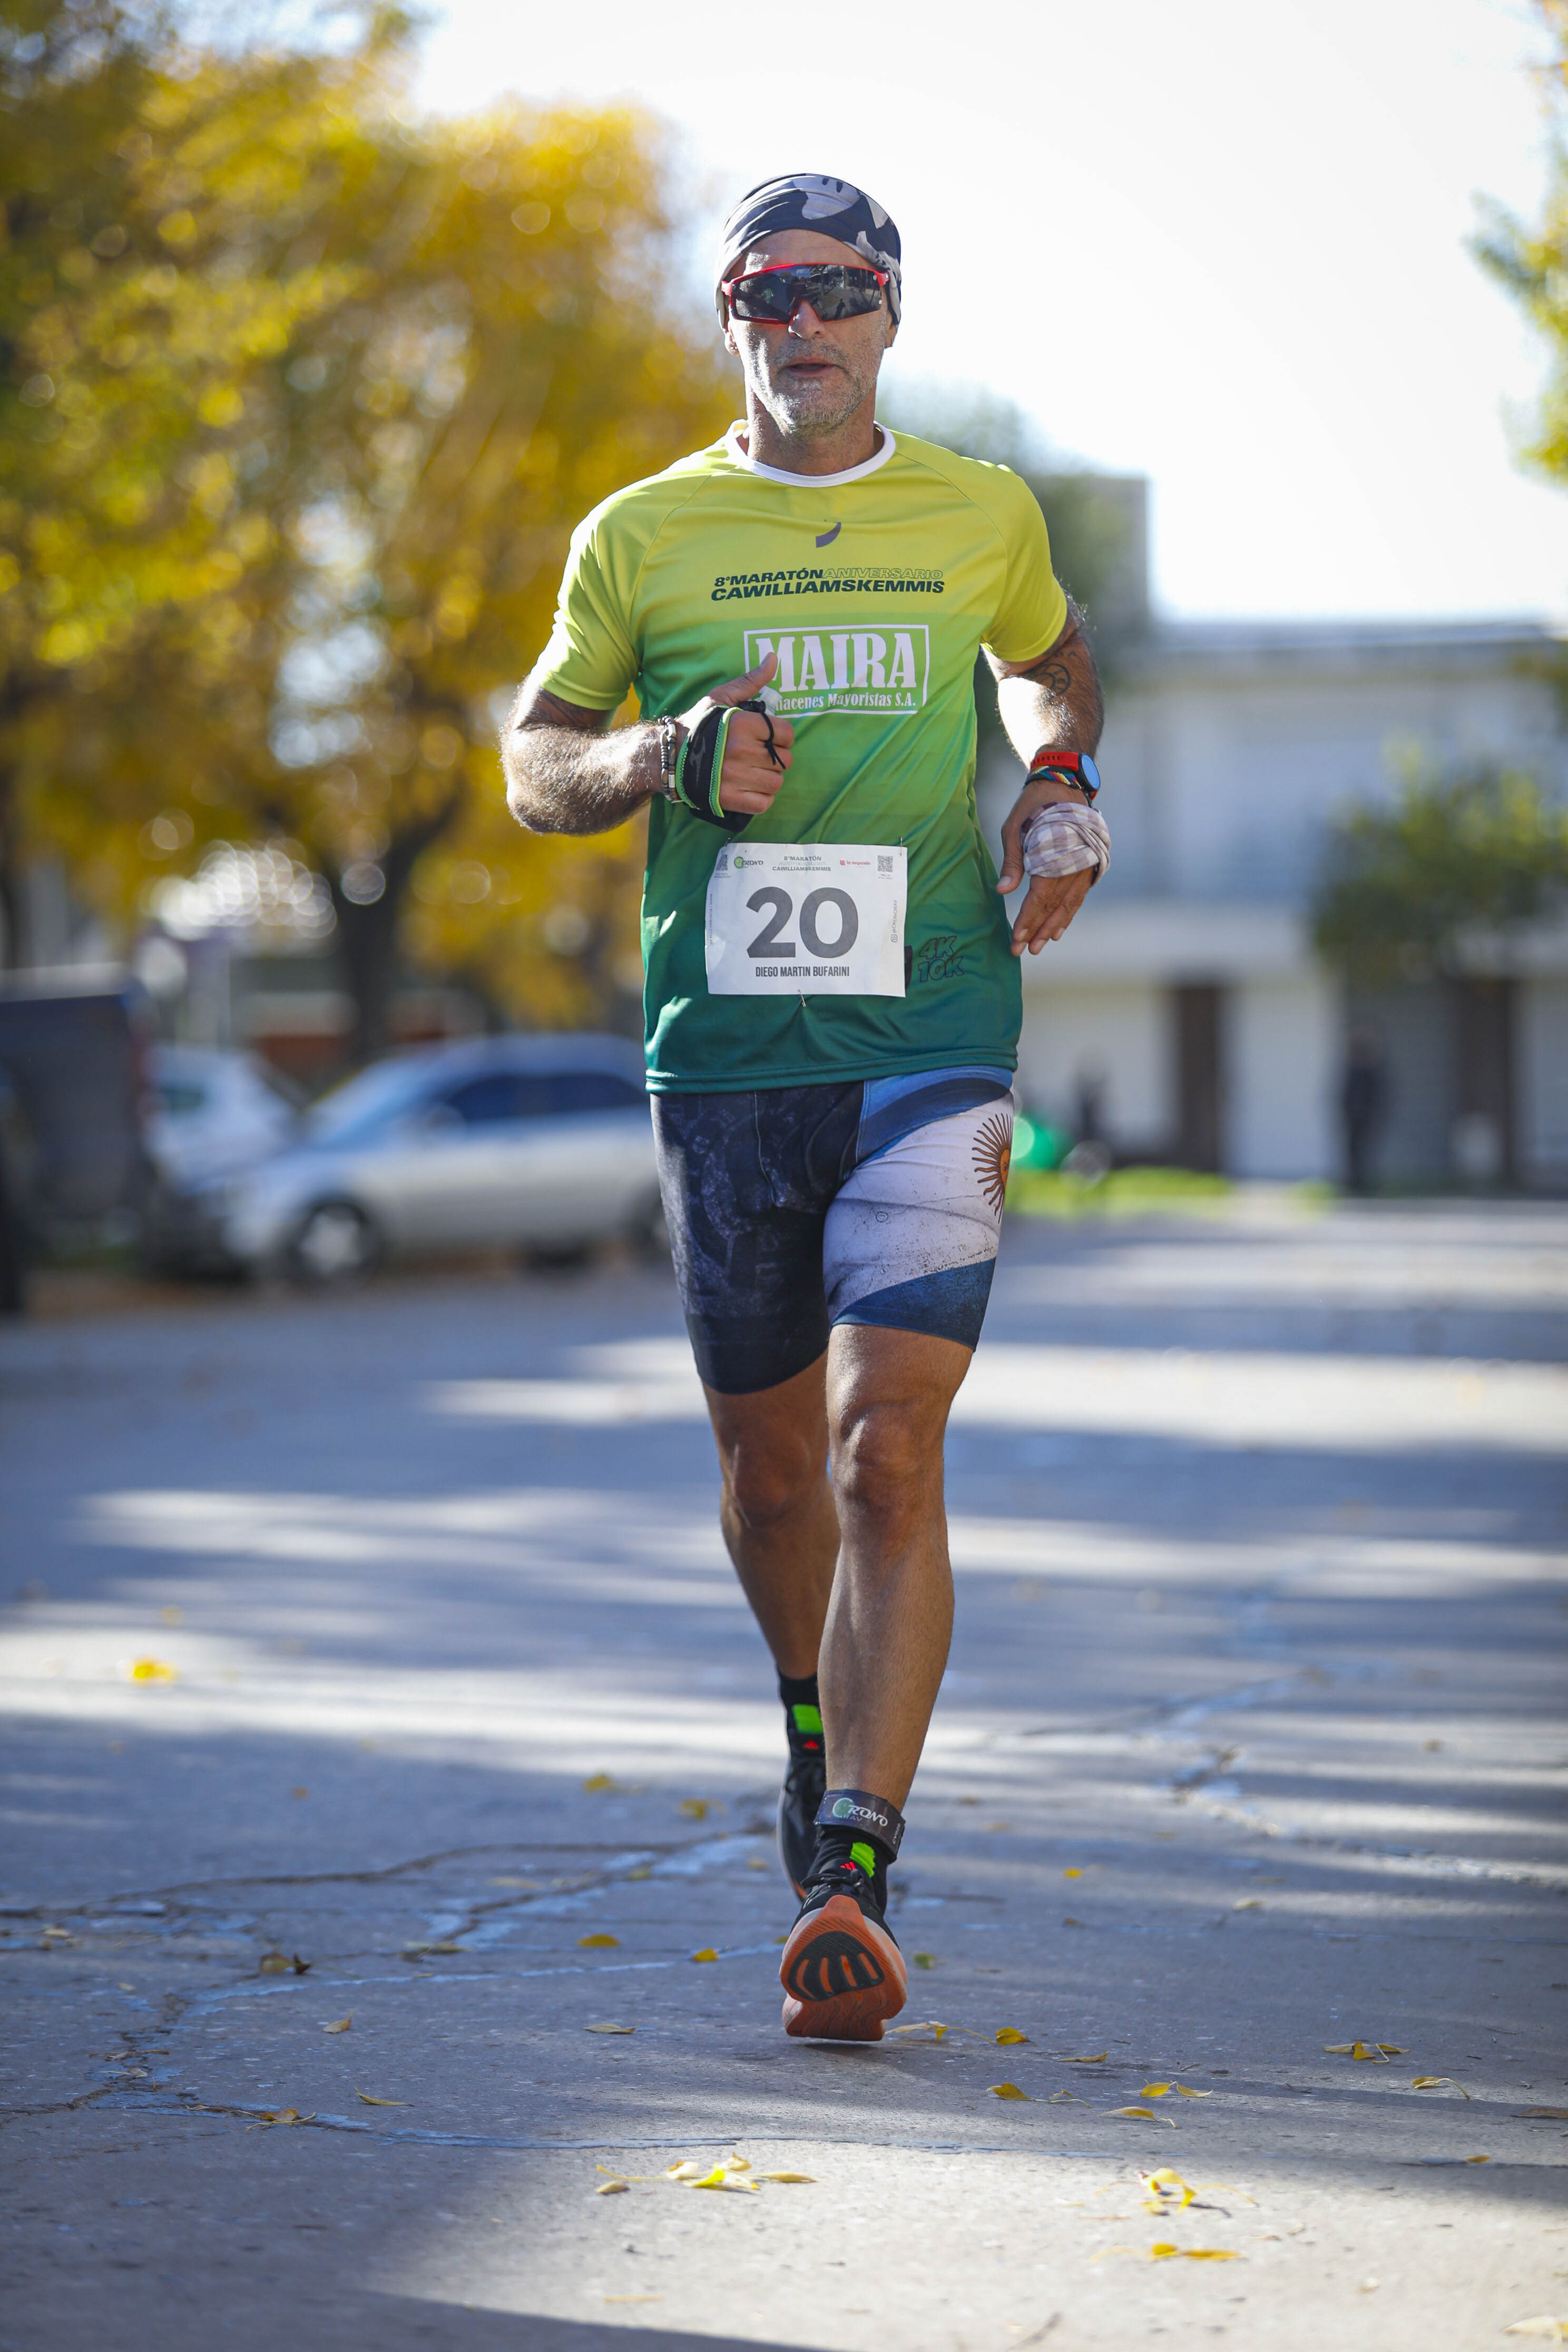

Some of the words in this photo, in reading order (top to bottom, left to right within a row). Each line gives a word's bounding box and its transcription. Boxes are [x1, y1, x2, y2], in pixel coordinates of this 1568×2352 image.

[711, 580, 945, 601] CAWILLIAMSKEMMIS
[756, 633, 917, 692] MAIRA
[828, 692, 891, 707] Mayoristas
[895, 692, 916, 707] S.A.
[746, 886, 859, 958] 20
[918, 935, 957, 960] 4K
[756, 966, 778, 977] DIEGO
[780, 966, 811, 977] MARTIN
[813, 966, 850, 976] BUFARINI
[918, 956, 965, 983] 10K
